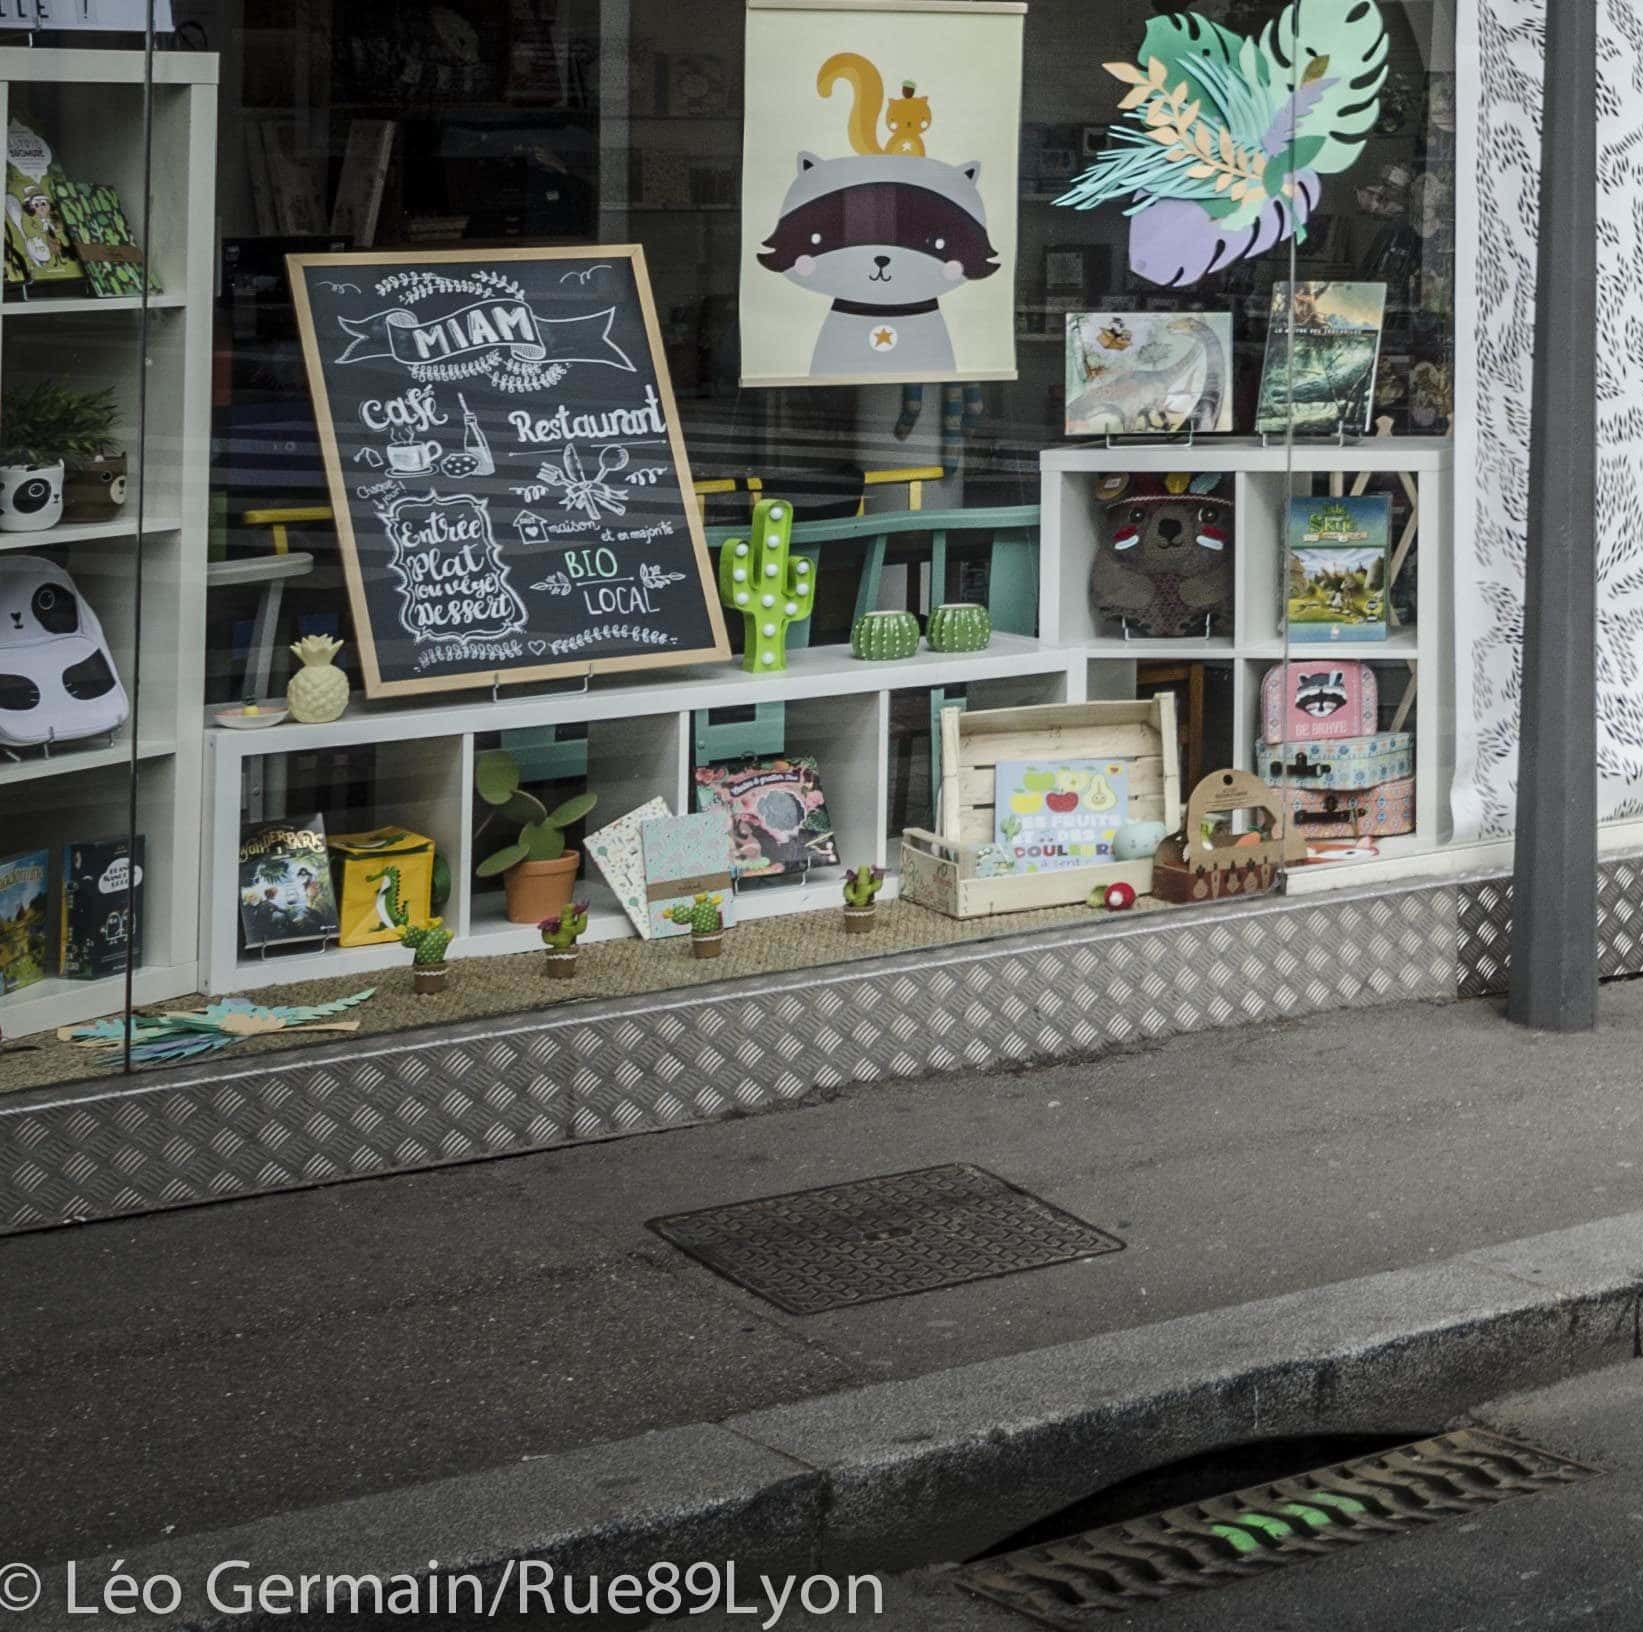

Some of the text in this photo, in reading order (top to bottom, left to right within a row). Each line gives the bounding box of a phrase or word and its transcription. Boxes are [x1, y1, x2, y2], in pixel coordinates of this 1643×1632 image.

[411, 307, 535, 359] MIAM
[358, 384, 449, 432] Café
[508, 384, 667, 443] Restaurant
[401, 512, 482, 548] Entrée
[406, 544, 485, 582] Plat
[564, 547, 618, 579] BIO
[414, 592, 511, 627] Dessert
[583, 585, 661, 616] LOCAL
